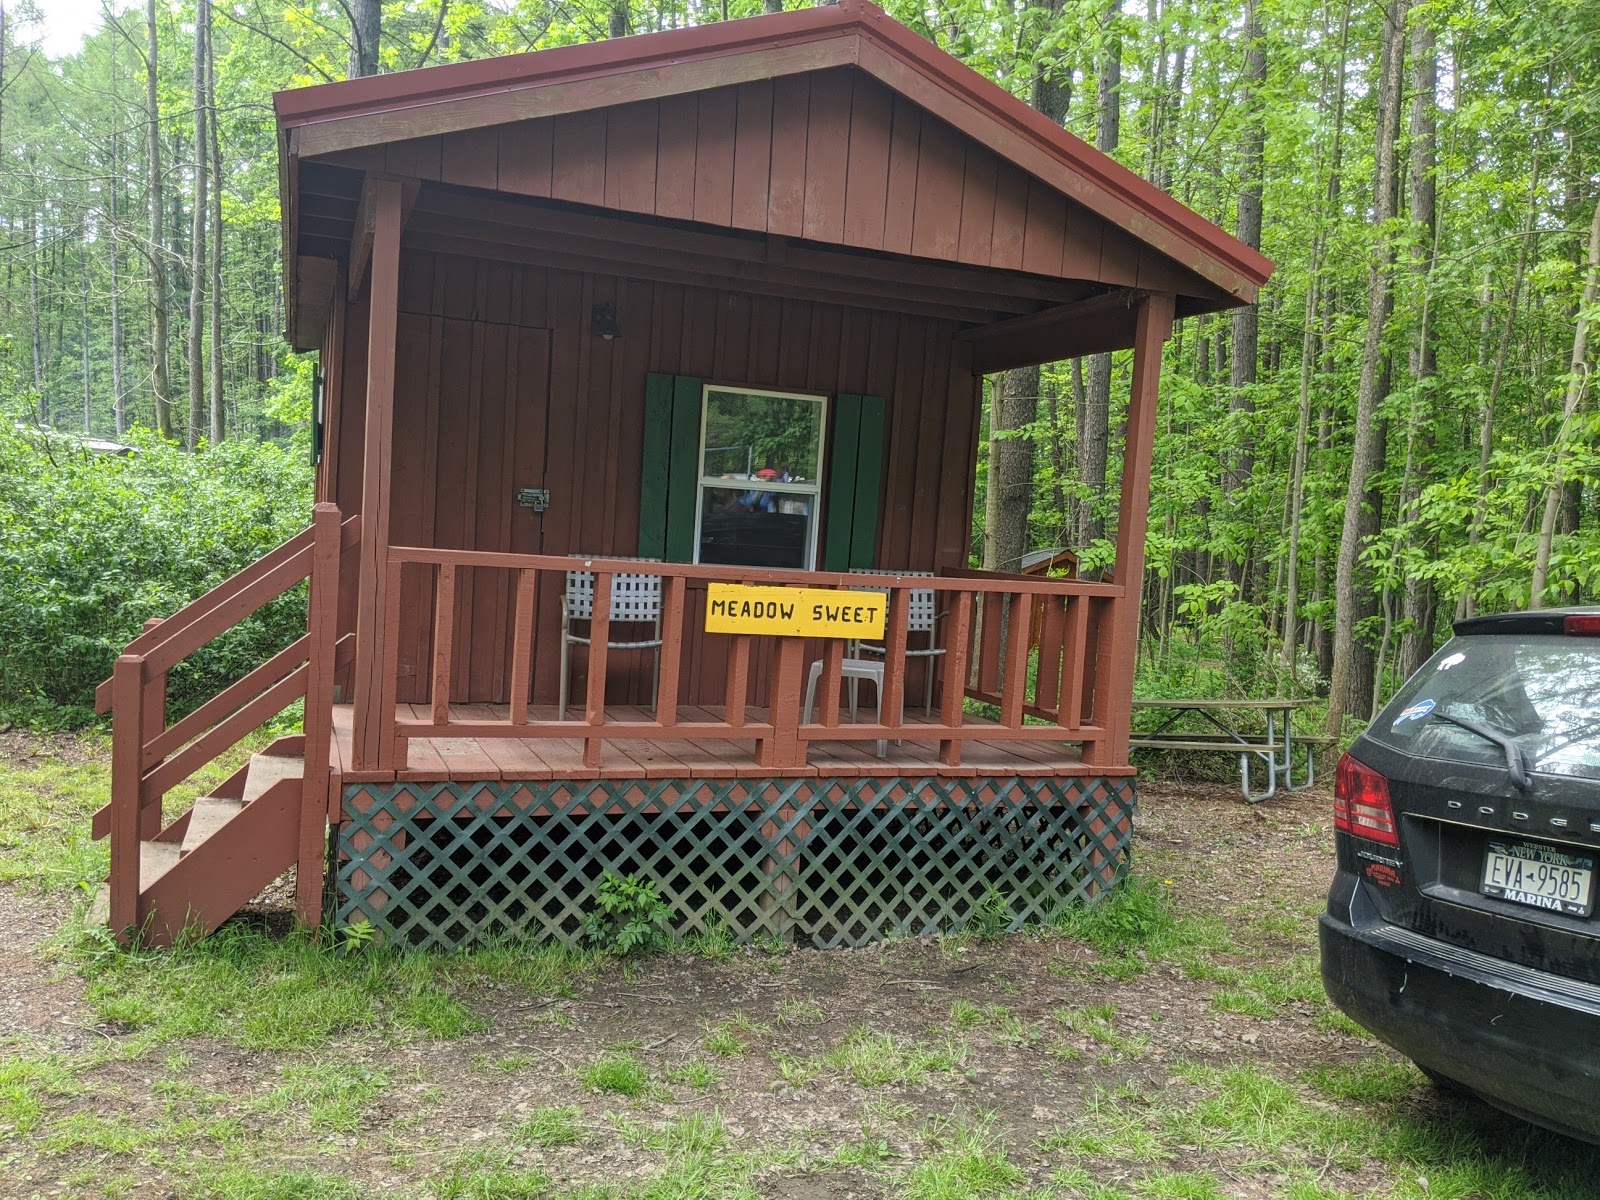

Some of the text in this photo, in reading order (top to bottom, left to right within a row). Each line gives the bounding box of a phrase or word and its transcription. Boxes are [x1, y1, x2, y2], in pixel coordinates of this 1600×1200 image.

[711, 600, 878, 623] MEADOW SWEET
[1448, 801, 1600, 832] DODGE
[1512, 847, 1567, 866] NEW YORK
[1523, 842, 1556, 853] WEBSTER
[1357, 851, 1403, 868] JOURNEY
[1492, 856, 1582, 900] EVA 9585
[1504, 889, 1562, 911] MARINA
